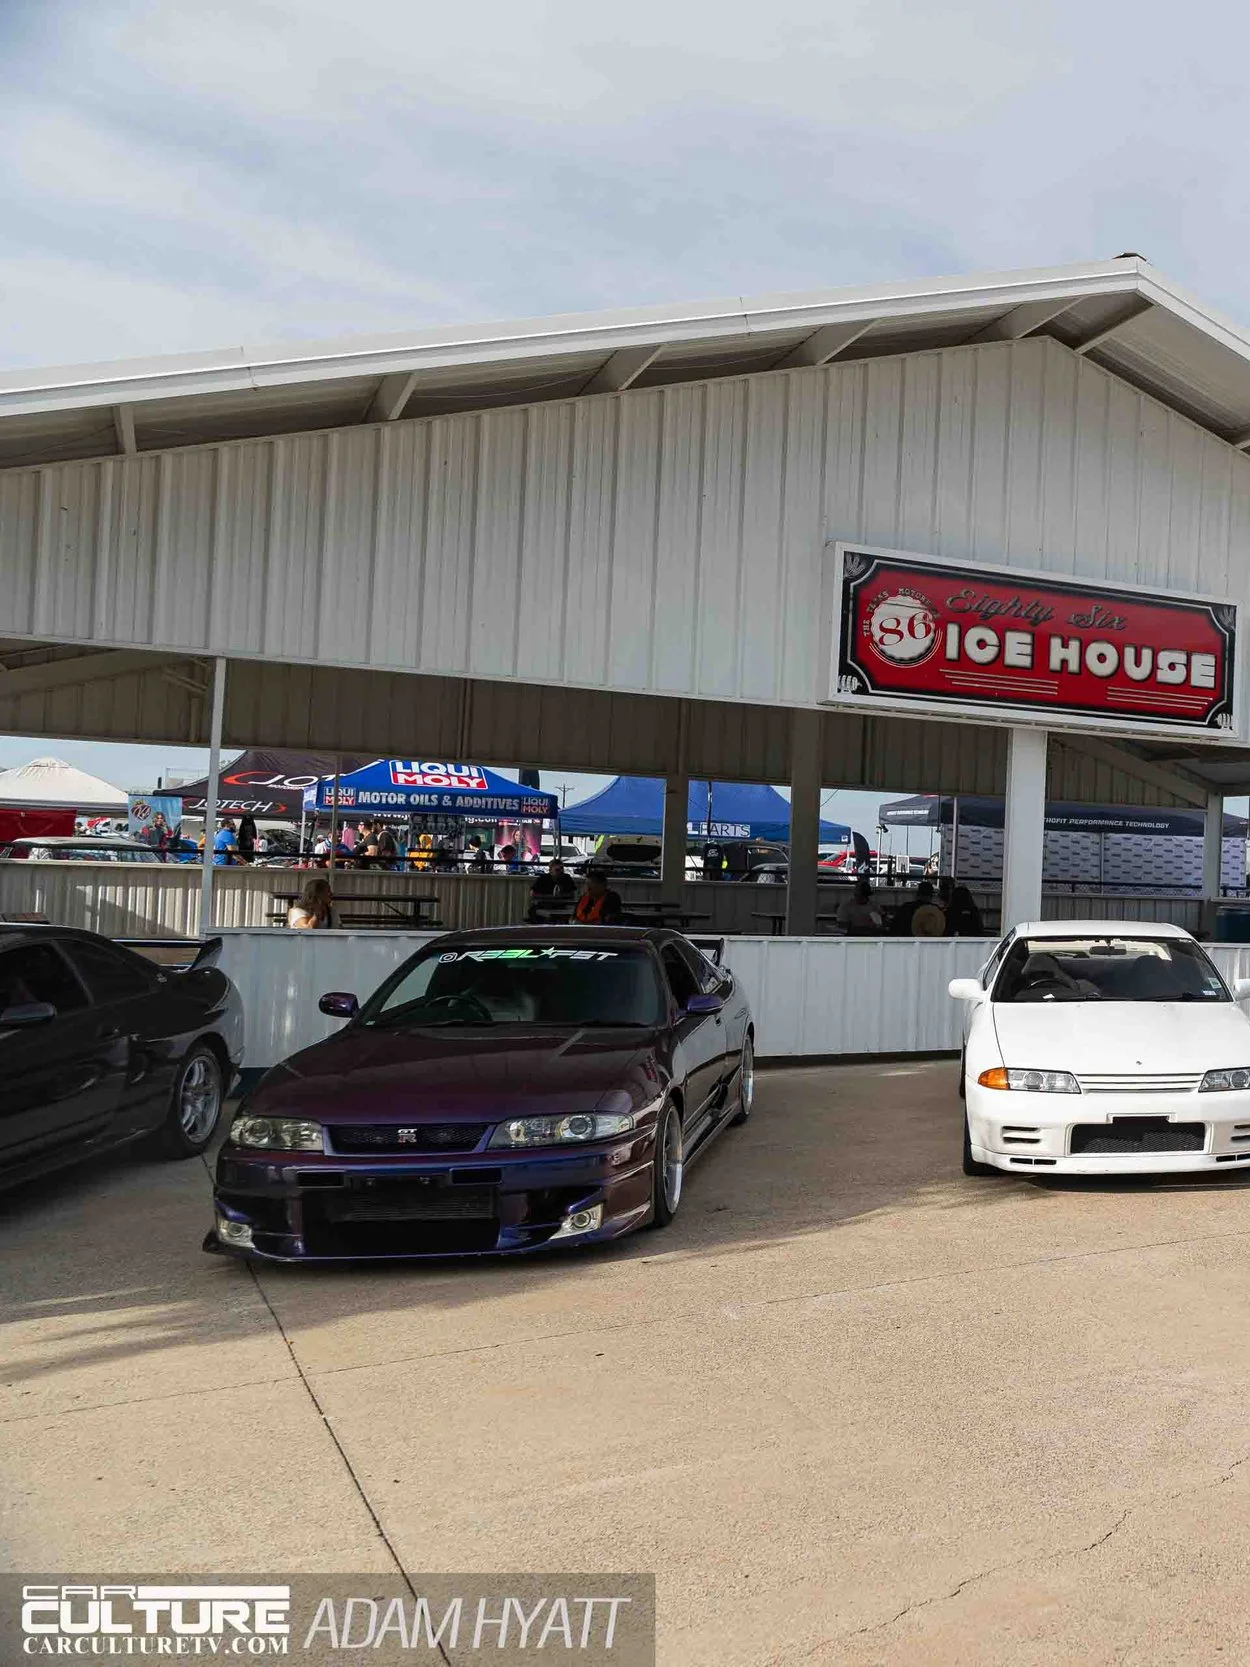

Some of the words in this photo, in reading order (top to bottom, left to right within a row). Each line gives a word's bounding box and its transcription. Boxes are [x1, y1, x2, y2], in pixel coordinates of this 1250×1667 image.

[946, 589, 1055, 626] Eighty
[1067, 604, 1127, 631] Six
[878, 611, 932, 646] 86
[944, 621, 1034, 669] ICE
[1049, 634, 1217, 690] HOUSE
[393, 761, 479, 777] LIQUI
[397, 774, 483, 788] MOLY
[358, 791, 406, 805] MOTOR
[411, 793, 439, 806] OILS
[443, 794, 452, 806] &
[455, 795, 520, 810] ADDITIVES
[523, 796, 549, 806] LIQUI
[523, 805, 548, 814] MOLY
[1125, 820, 1169, 829] TECHNOLOGY
